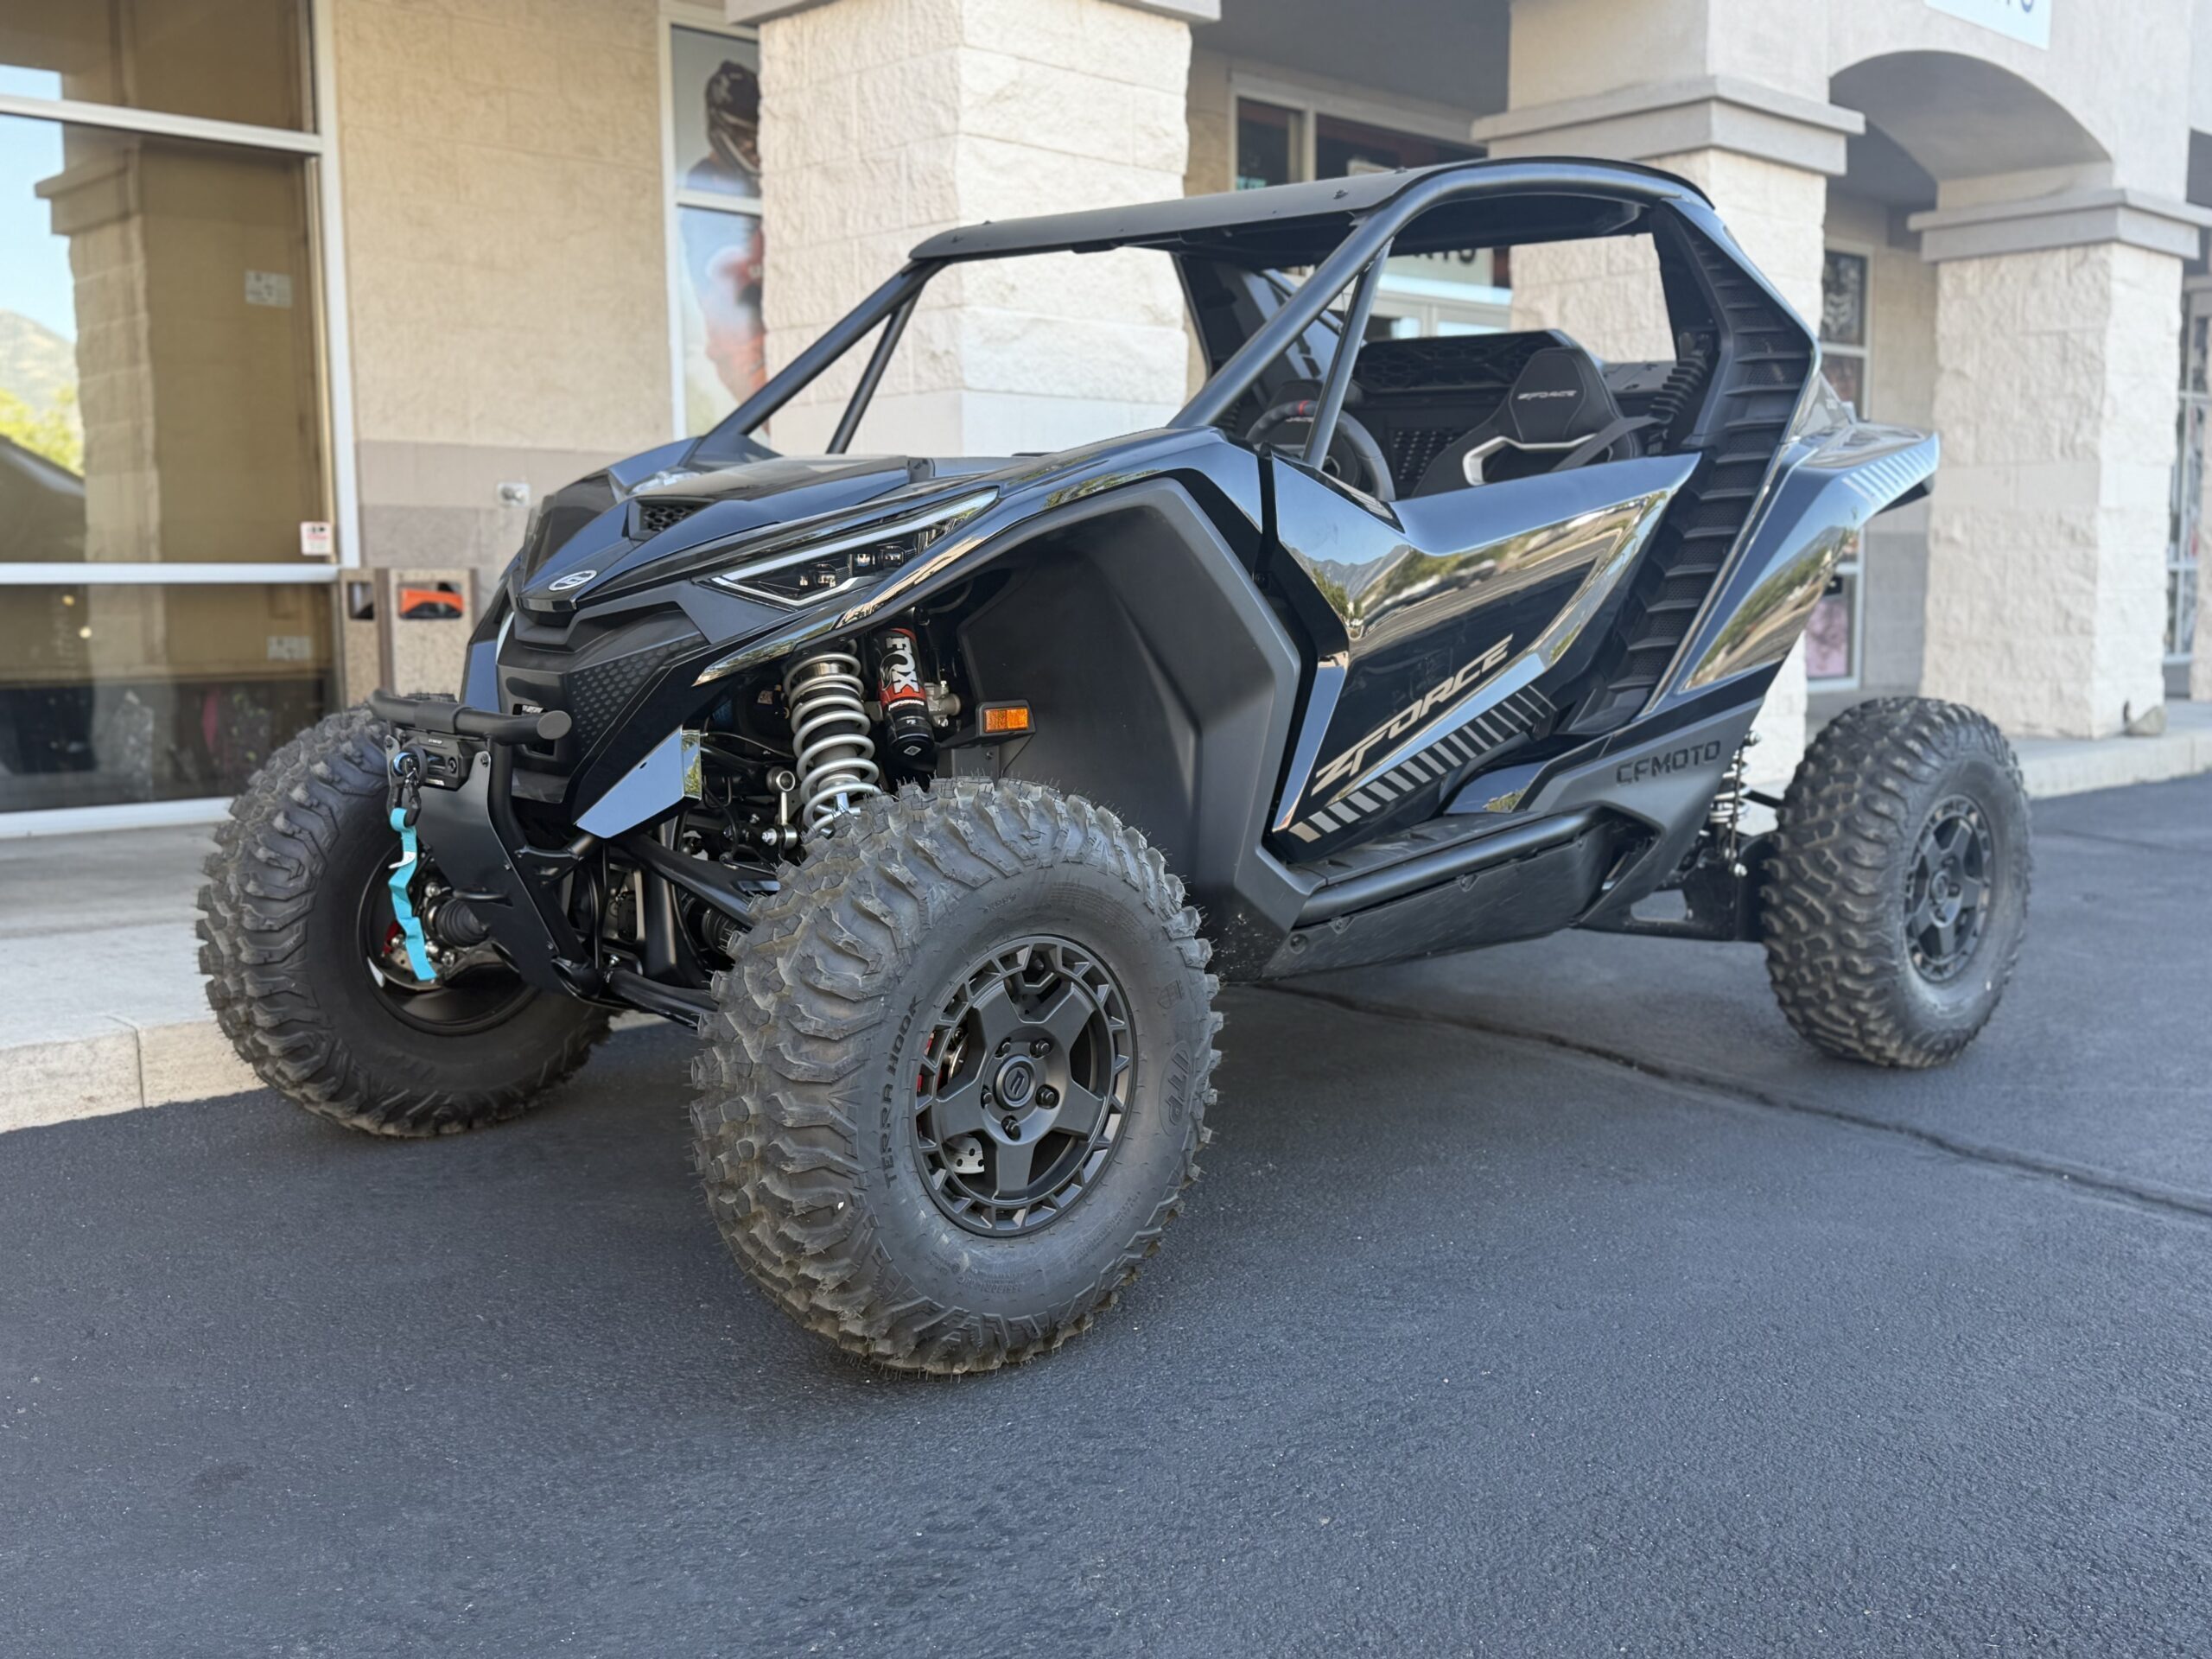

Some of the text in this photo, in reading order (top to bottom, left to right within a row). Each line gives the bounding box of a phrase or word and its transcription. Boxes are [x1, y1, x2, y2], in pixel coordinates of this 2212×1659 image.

[880, 637, 920, 694] FOX
[1311, 633, 1514, 797] ZFORCE
[1615, 740, 1721, 785] CFMOTO
[880, 995, 922, 1190] TERRA HOOK
[1164, 1050, 1190, 1127] ITP
